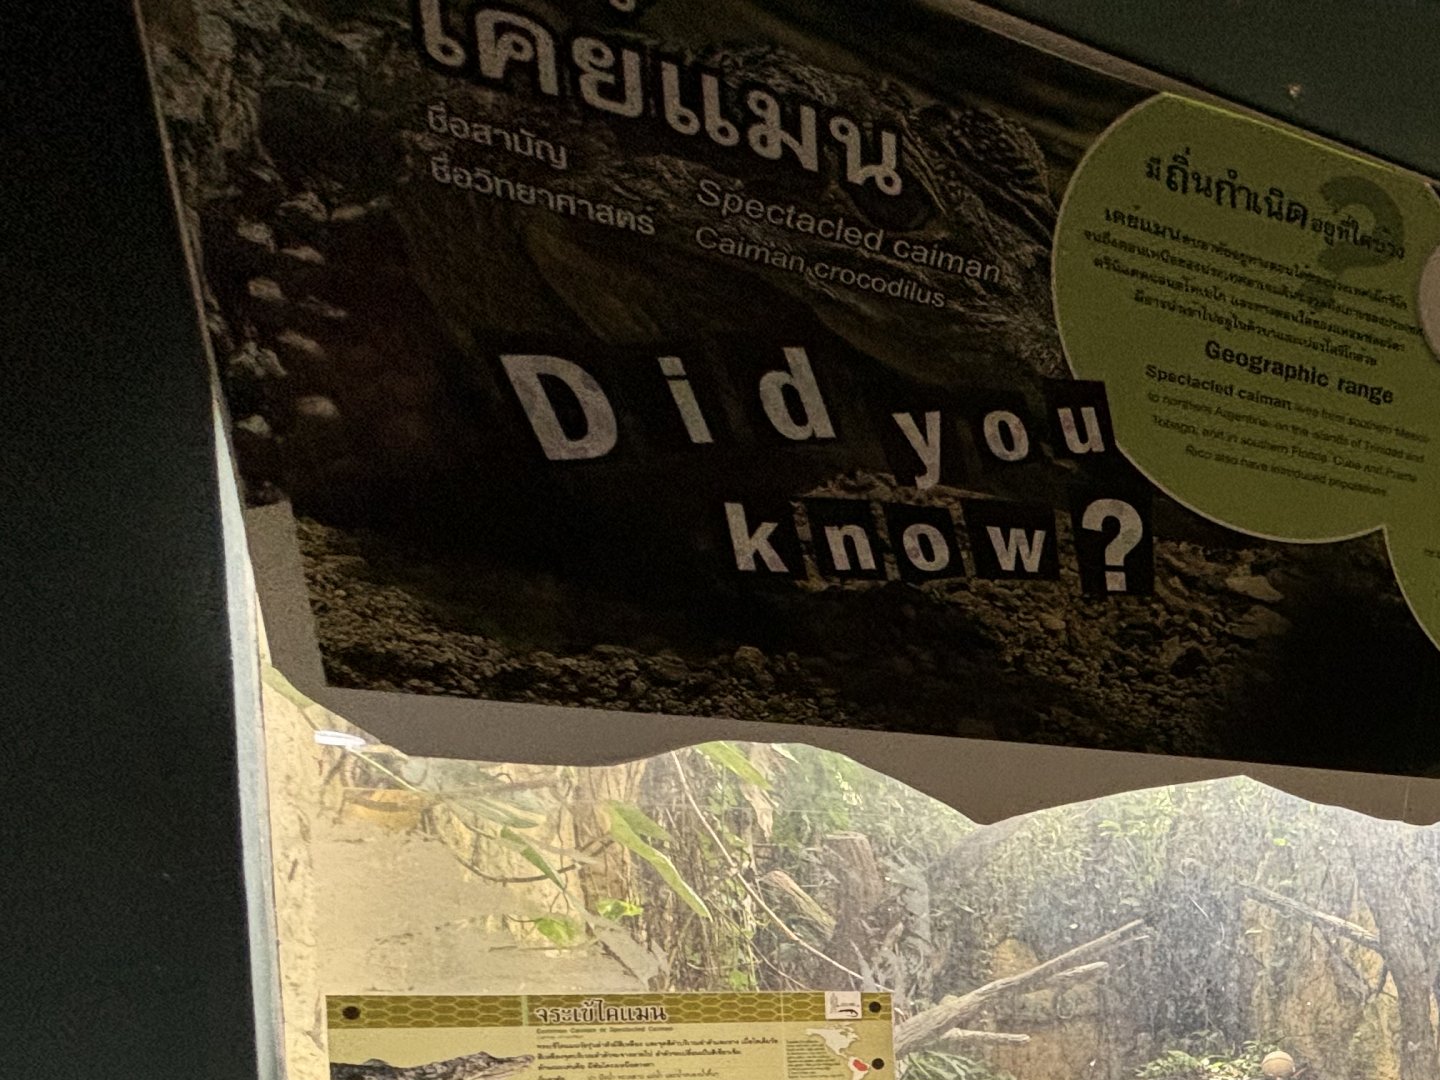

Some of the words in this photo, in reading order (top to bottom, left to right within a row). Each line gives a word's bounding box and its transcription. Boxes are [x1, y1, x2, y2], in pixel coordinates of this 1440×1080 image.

[427, 102, 568, 171] ชื่อสามัญ
[430, 151, 656, 237] ชื่อวิทยาศาสตร์
[697, 179, 884, 253] Spectacled
[892, 232, 1001, 284] caiman
[695, 227, 805, 274] Caiman
[814, 259, 946, 309] crocodilus
[1145, 364, 1234, 397] Spectacled
[1238, 387, 1292, 411] caiman
[1205, 340, 1329, 388] Geographic
[1337, 377, 1394, 405] range
[499, 346, 836, 461] Did
[892, 403, 1105, 490] you
[723, 498, 1144, 591] know?
[536, 999, 667, 1022] จระเข้ไคแมน
